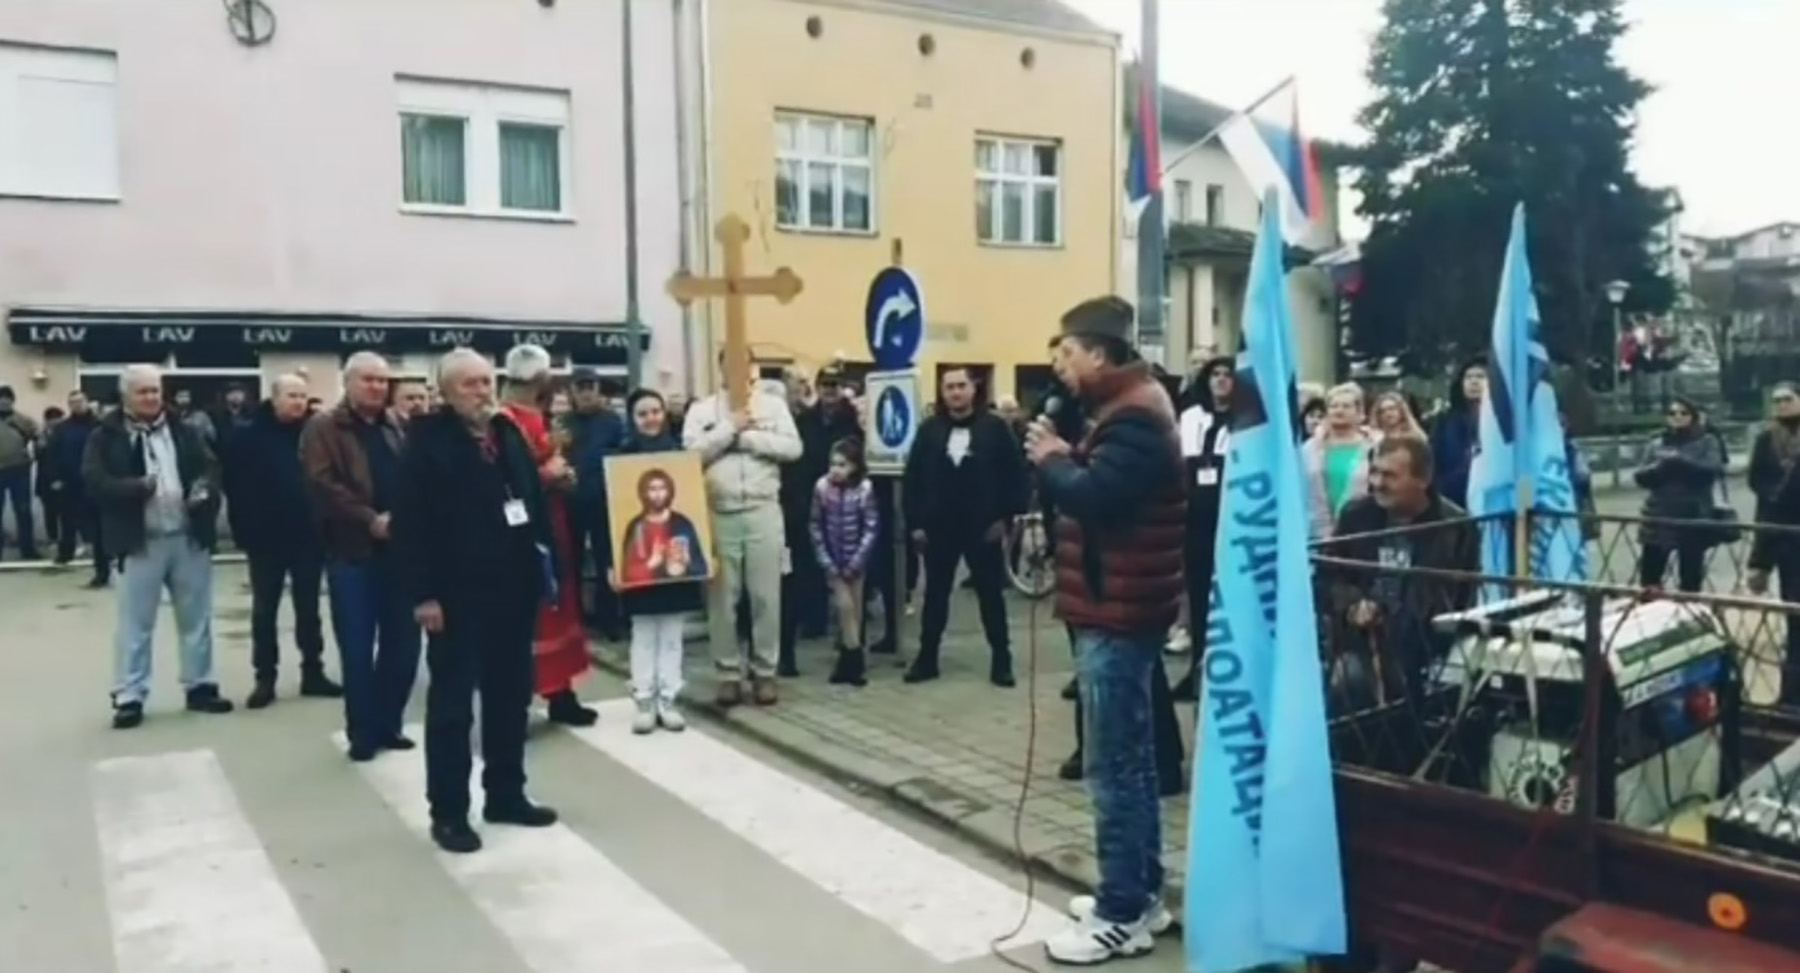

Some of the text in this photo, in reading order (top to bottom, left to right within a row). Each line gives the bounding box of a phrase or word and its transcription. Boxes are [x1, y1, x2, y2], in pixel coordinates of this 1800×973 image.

[29, 325, 87, 342] LAV
[142, 326, 196, 343] LAV
[243, 328, 293, 344] LAV
[339, 328, 387, 344] LAV
[429, 330, 474, 345] LAV
